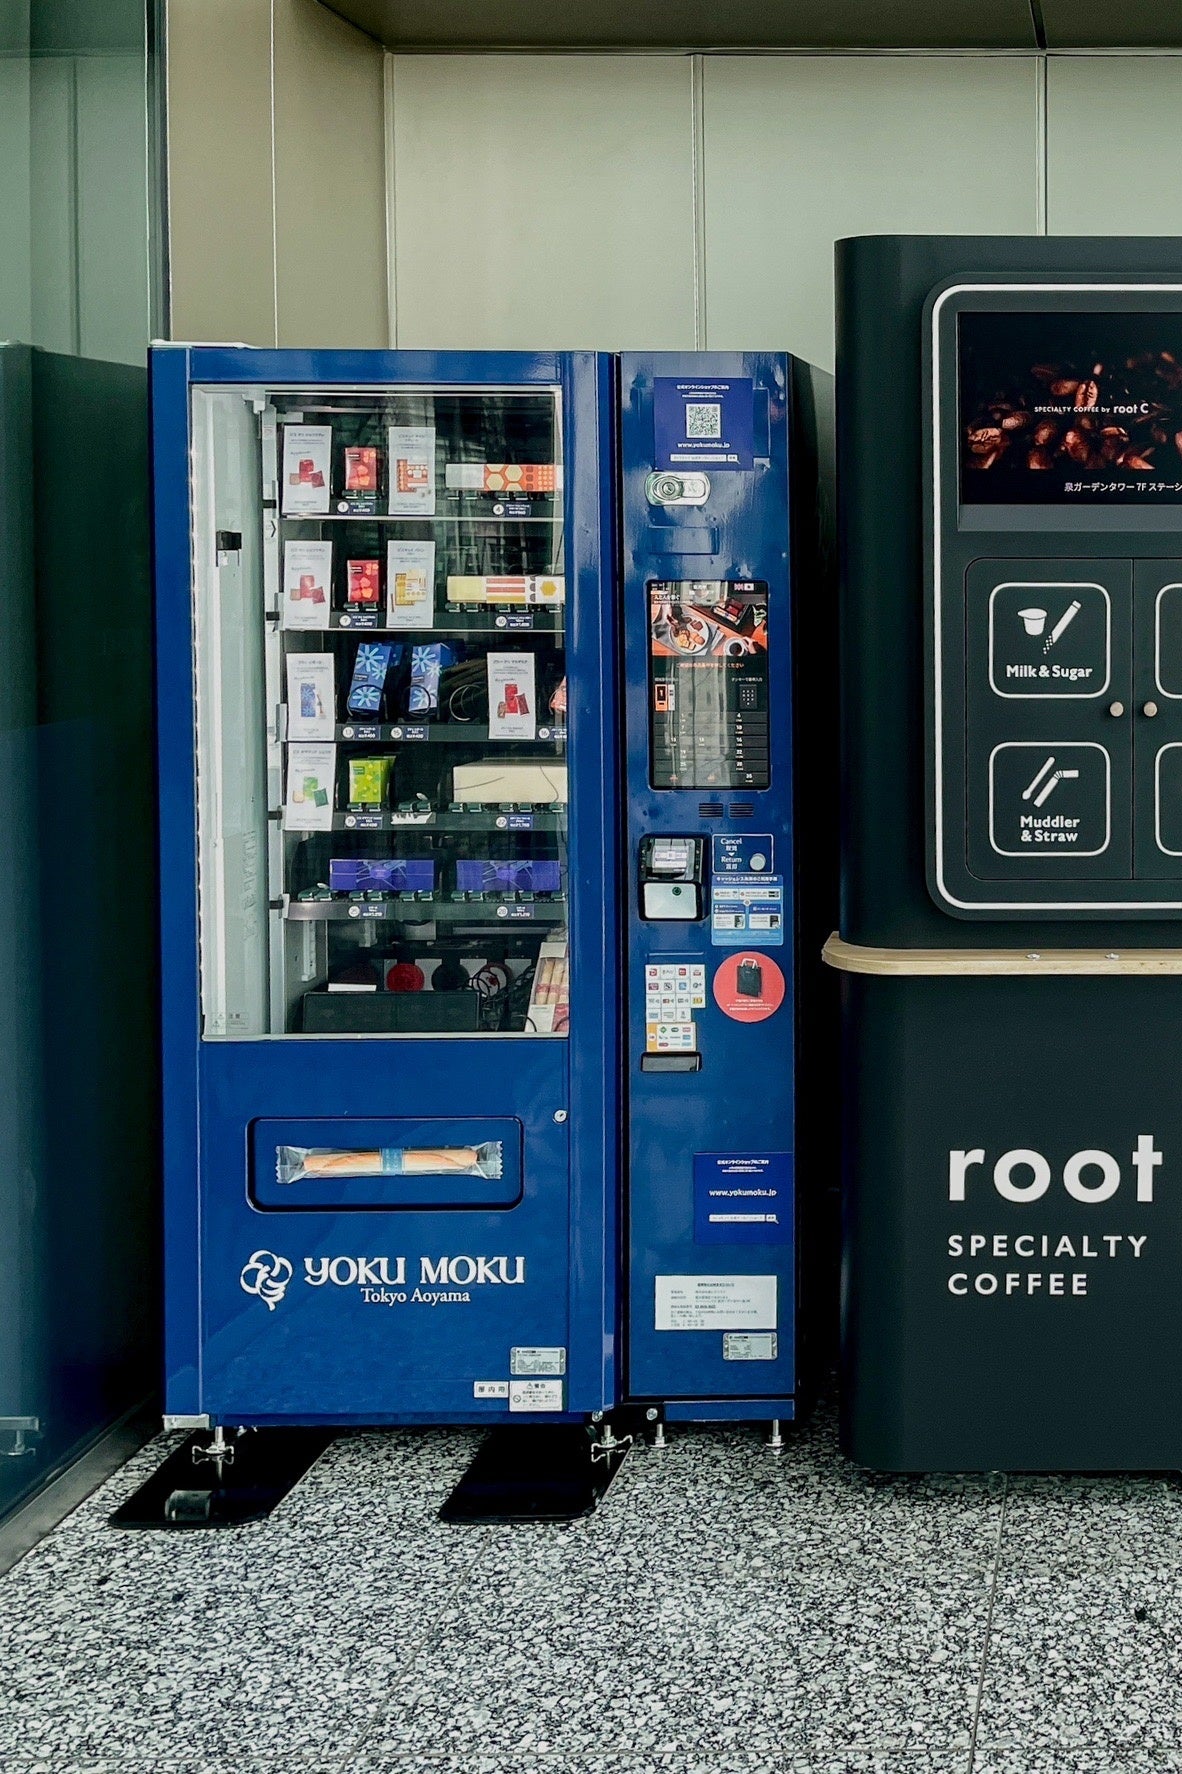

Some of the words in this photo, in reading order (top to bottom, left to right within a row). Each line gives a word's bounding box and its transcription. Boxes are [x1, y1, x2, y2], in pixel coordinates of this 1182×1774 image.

[1101, 406, 1110, 414] by
[1113, 404, 1138, 414] root
[1140, 403, 1149, 414] C
[1064, 482, 1135, 492] 泉ガーデンタワー
[1136, 482, 1147, 492] 7F
[1006, 664, 1037, 678] Milk
[1039, 665, 1050, 678] &
[1052, 665, 1092, 681] Sugar
[1020, 815, 1080, 828] Muddler
[1021, 830, 1032, 842] &
[1034, 830, 1078, 842] Straw
[949, 1134, 1162, 1203] root
[709, 1188, 777, 1197] www.yokumoku.jp
[948, 1234, 1148, 1258] SPECIALTY
[304, 1256, 406, 1286] YOKU
[420, 1256, 525, 1284] MOKU
[948, 1273, 1088, 1295] COFFEE
[360, 1288, 406, 1307] Tokyo
[411, 1288, 471, 1306] Aoyama
